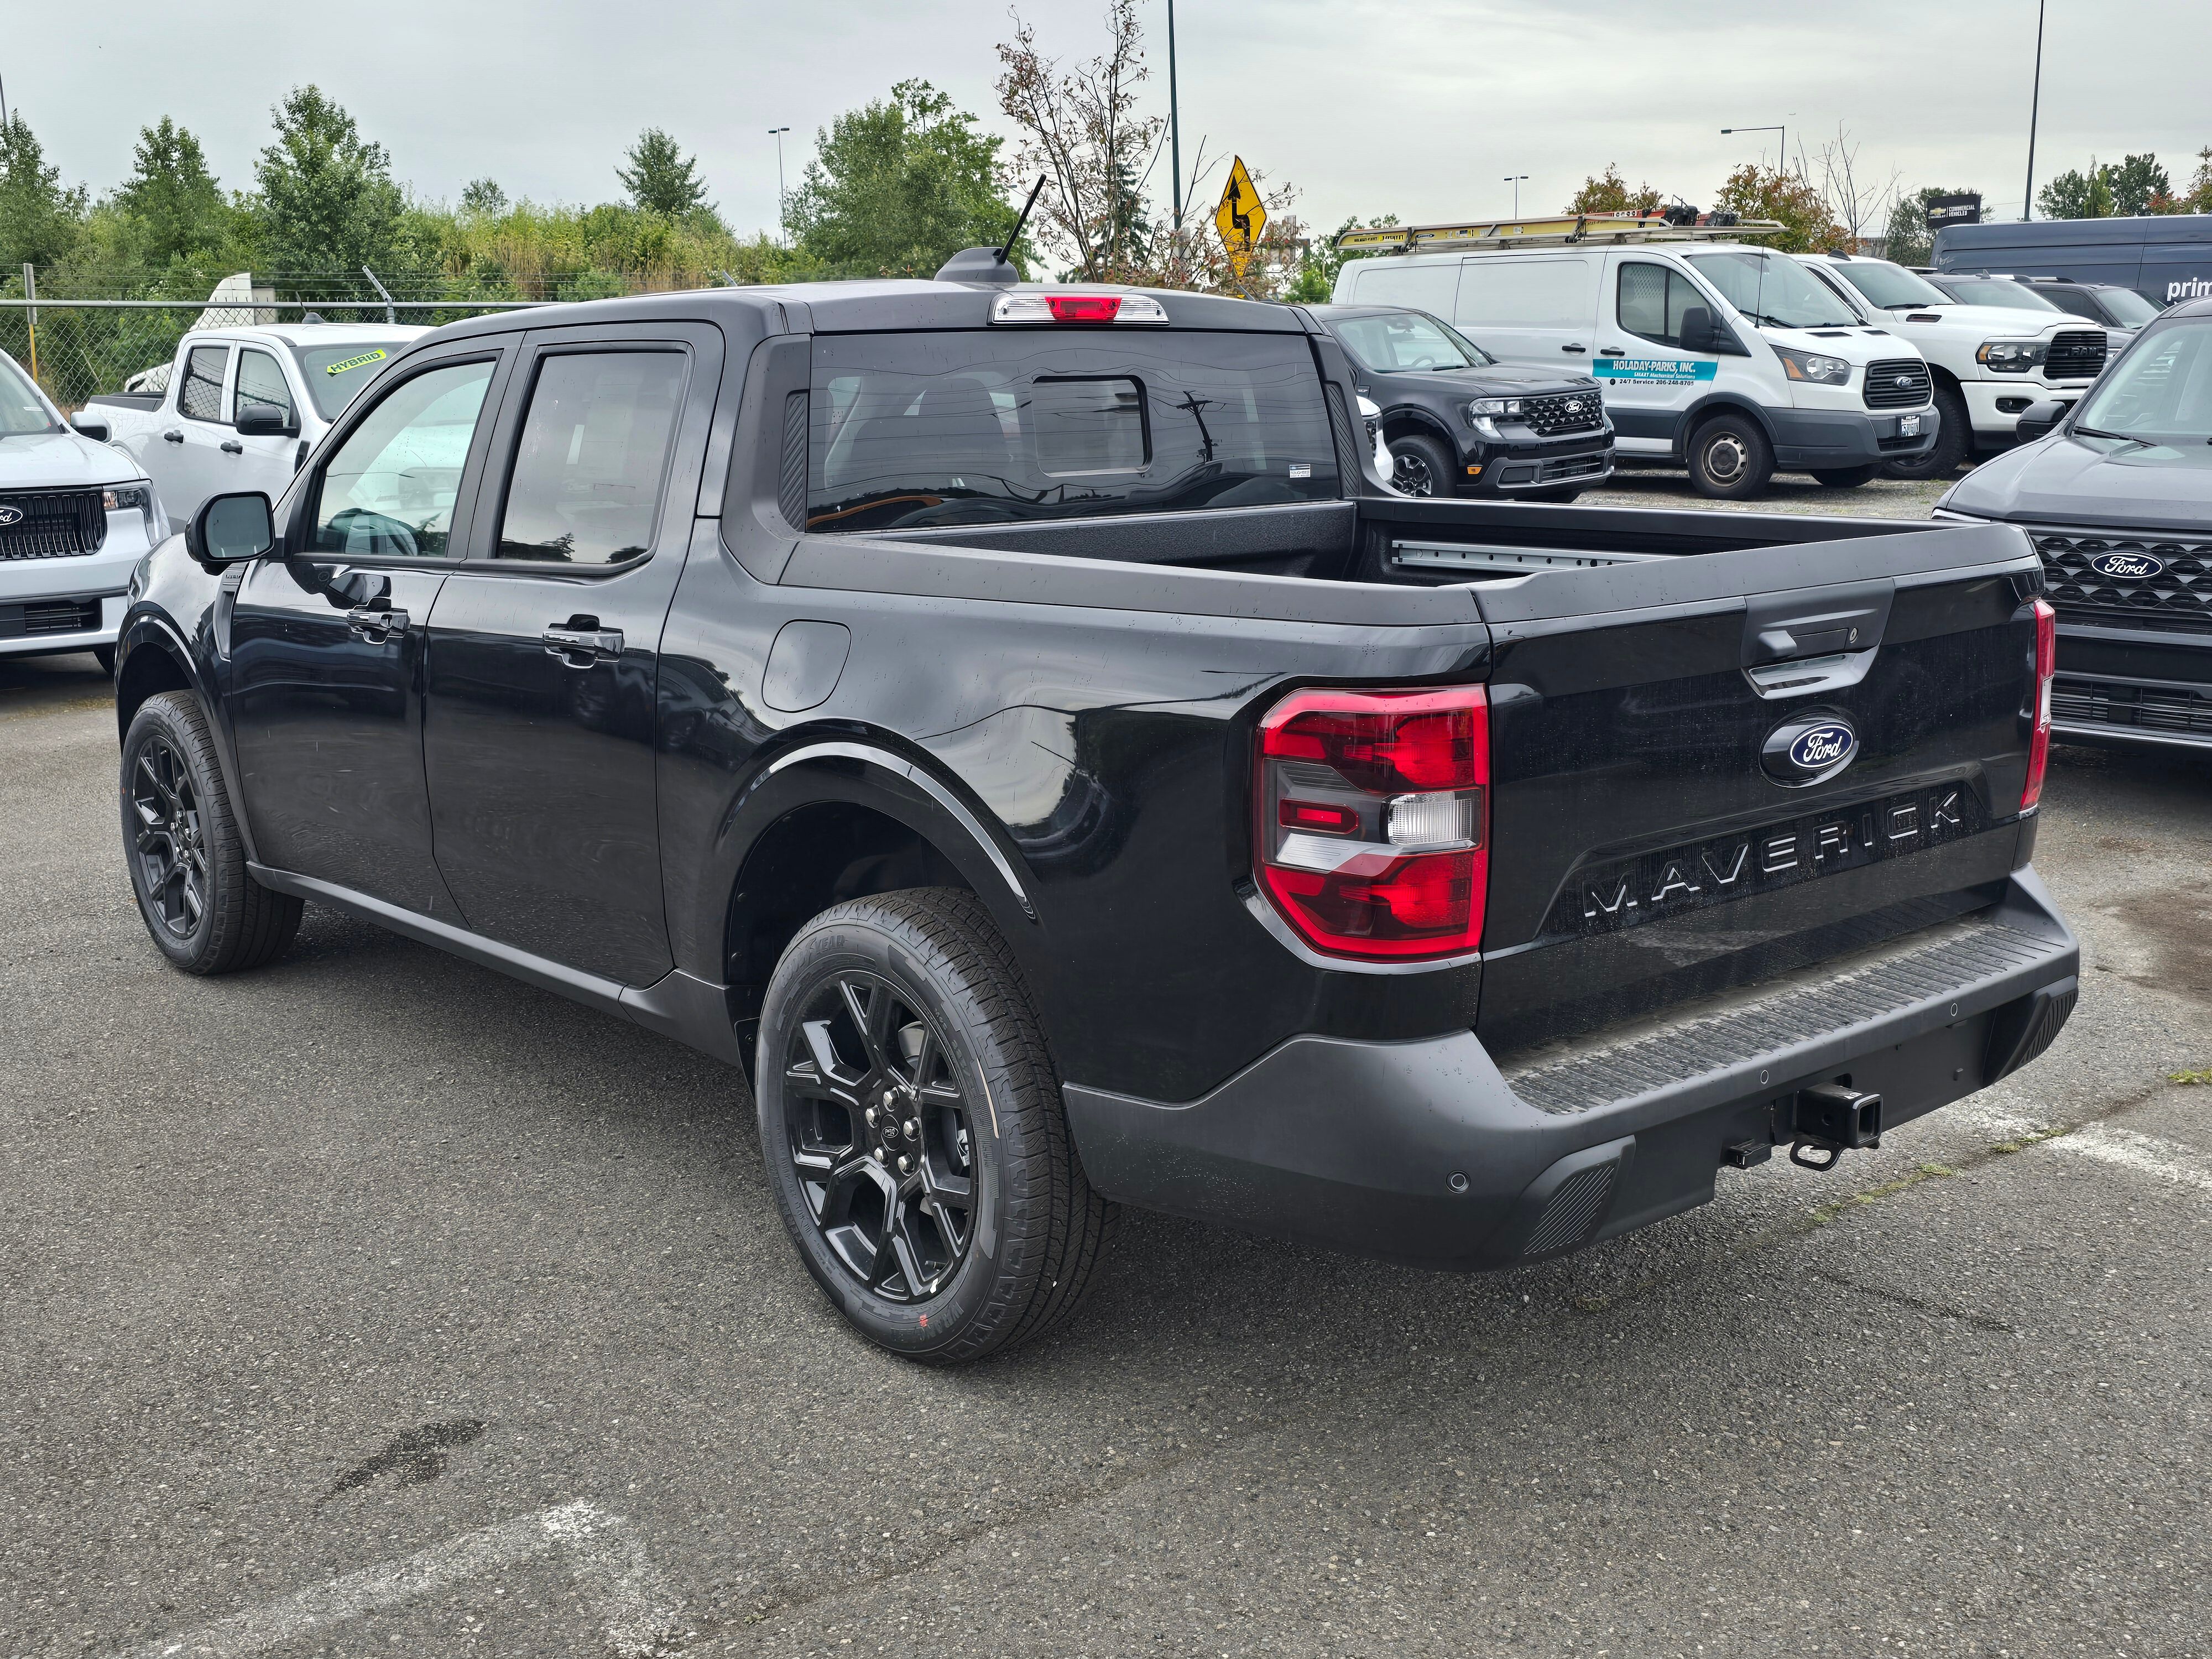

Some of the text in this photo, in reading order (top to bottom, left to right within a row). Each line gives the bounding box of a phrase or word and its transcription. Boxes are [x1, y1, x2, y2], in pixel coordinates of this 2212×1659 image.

[2071, 347, 2096, 356] RAM
[330, 353, 380, 372] HYBRID
[1613, 360, 1695, 374] HOLADAY-PARKS, INC.
[2104, 556, 2149, 575] Ford
[1803, 731, 1843, 763] Ford
[1583, 791, 1960, 918] MAVERICK
